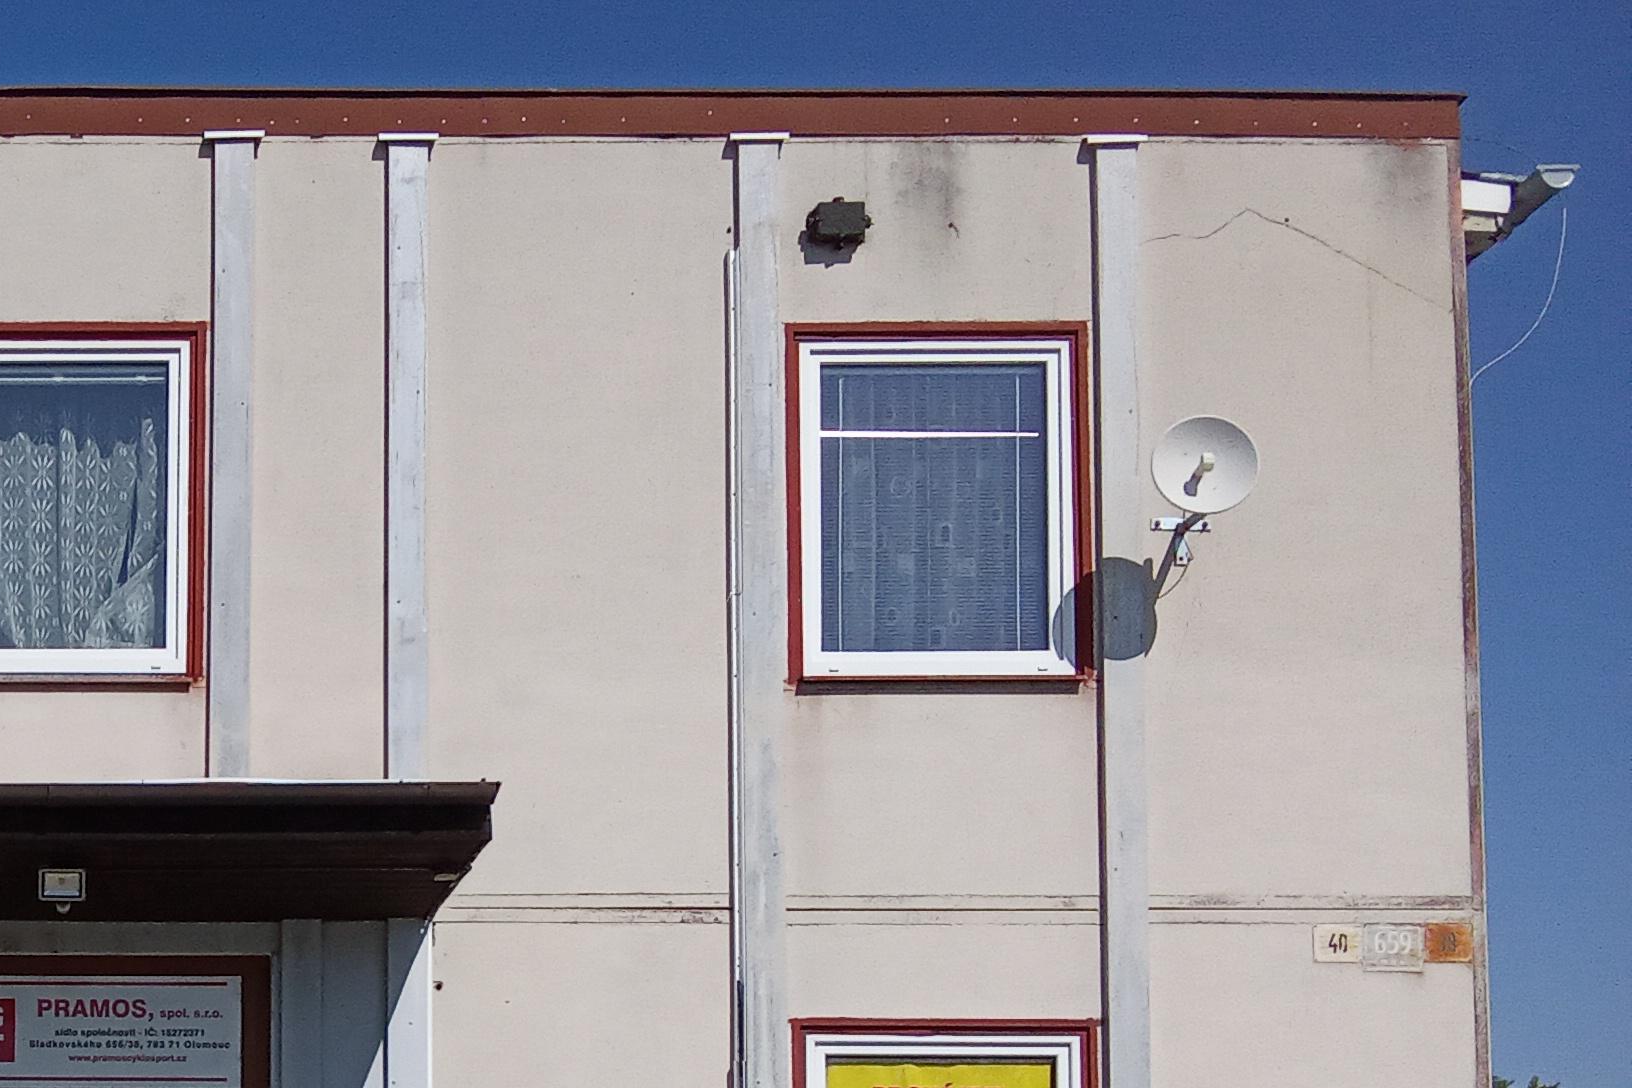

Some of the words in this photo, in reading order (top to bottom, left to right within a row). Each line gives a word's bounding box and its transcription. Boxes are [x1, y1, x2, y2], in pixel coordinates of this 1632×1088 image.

[1374, 931, 1411, 954] 659
[36, 999, 154, 1021] PRAMOS,
[160, 1009, 190, 1020] spol.
[194, 1009, 224, 1019] s.r.o.
[184, 1040, 231, 1049] Olomouc
